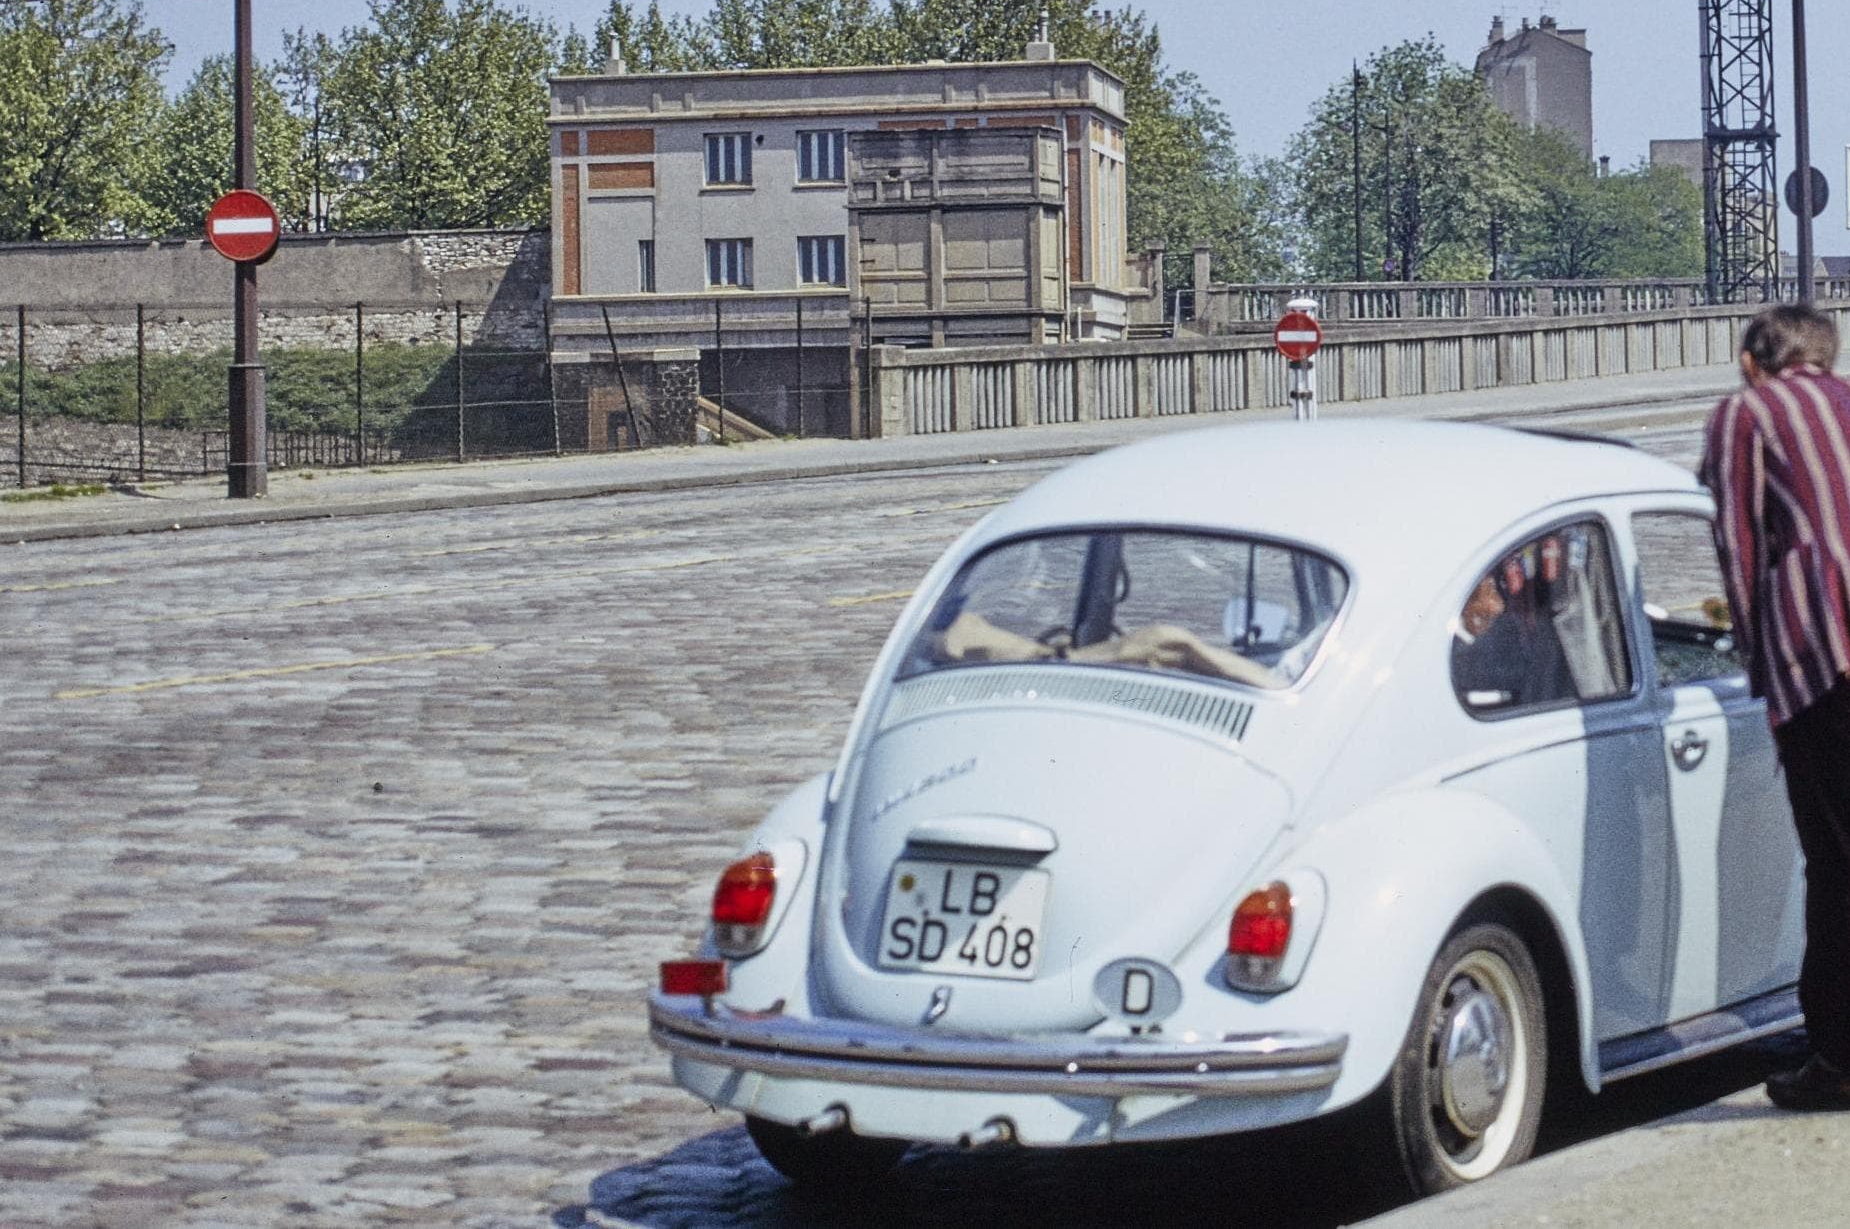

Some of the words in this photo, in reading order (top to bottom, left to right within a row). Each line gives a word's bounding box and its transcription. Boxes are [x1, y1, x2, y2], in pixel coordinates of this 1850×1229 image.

[940, 870, 1001, 917] LB
[888, 917, 948, 963] SD
[959, 923, 1034, 969] 408
[1121, 968, 1154, 1015] D
